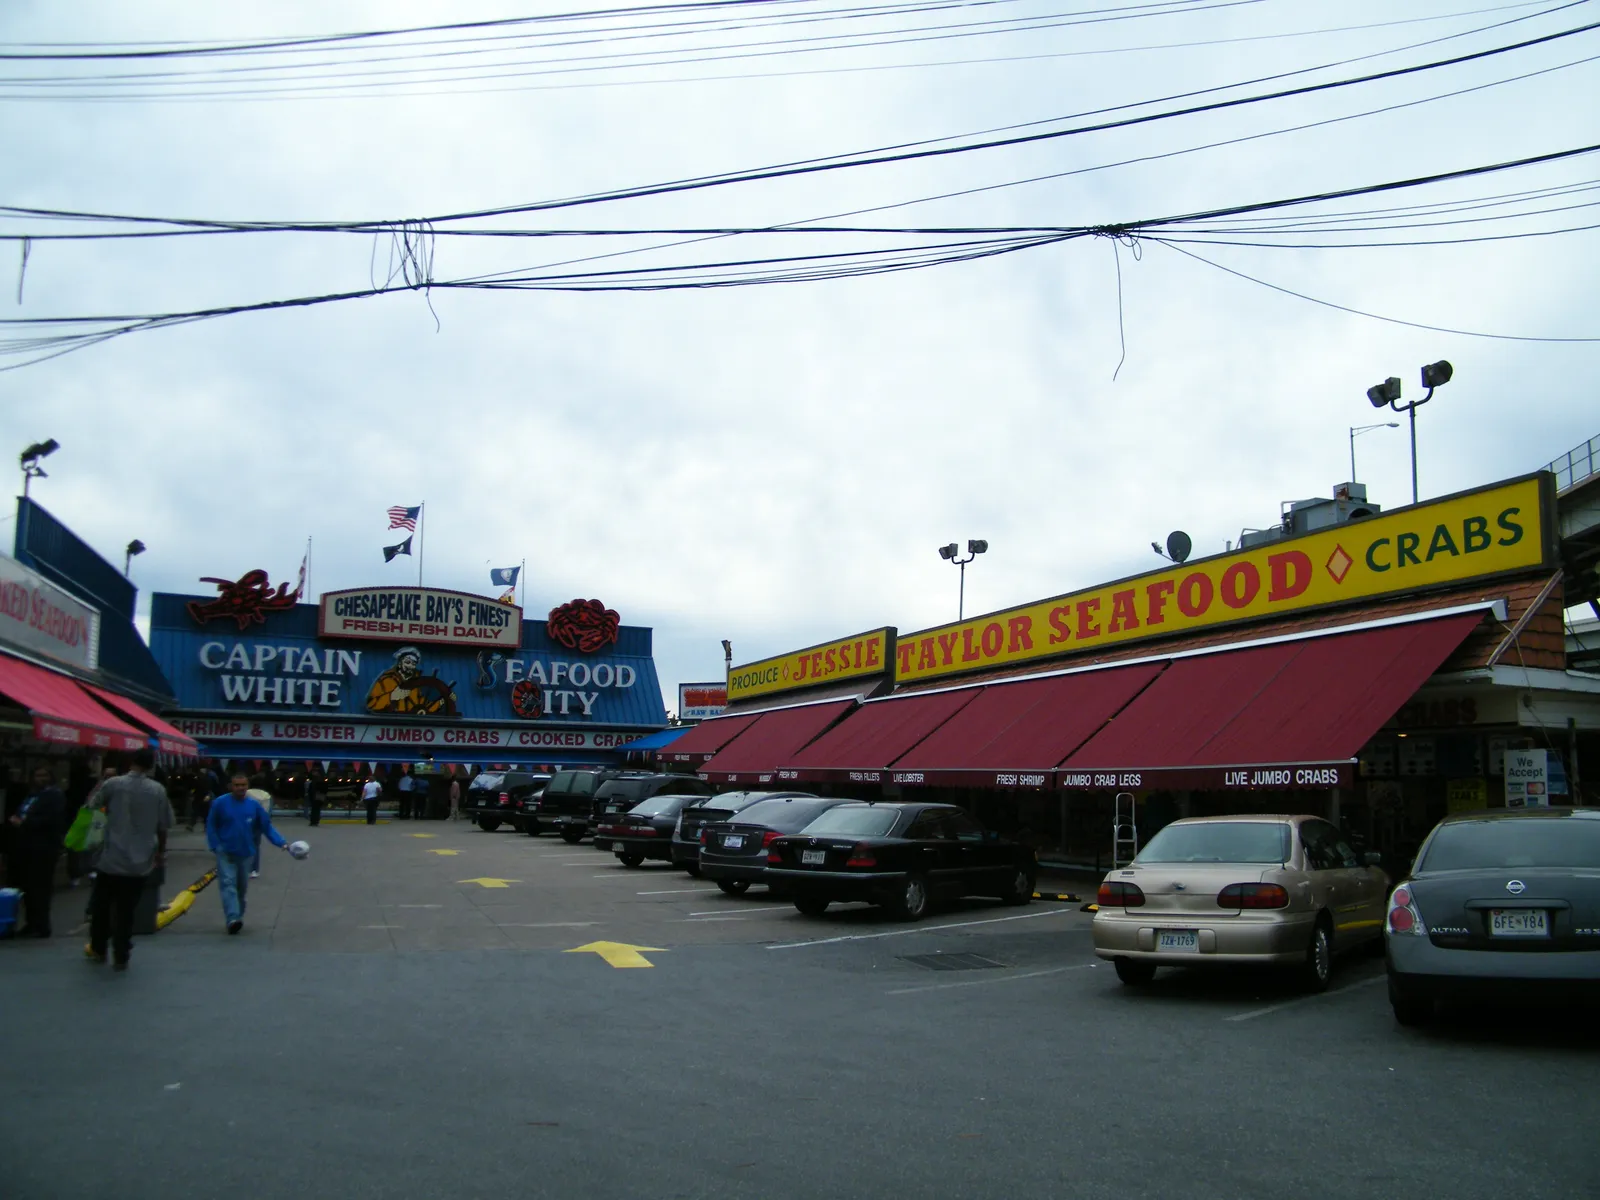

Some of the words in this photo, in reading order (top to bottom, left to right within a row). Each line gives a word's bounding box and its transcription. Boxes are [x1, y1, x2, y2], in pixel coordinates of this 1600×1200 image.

[1366, 507, 1524, 572] CRABS
[334, 594, 420, 621] CHESAPEAKE
[426, 595, 463, 624] BAY'S
[468, 601, 511, 627] FINEST
[897, 616, 1034, 674] TAYLOR
[1049, 550, 1313, 645] SEAFOOD
[342, 619, 403, 633] FRESH
[408, 624, 448, 636] FISH
[453, 627, 502, 639] DAILY
[200, 641, 362, 676] CAPTAIN
[731, 667, 779, 691] PRODUCE
[793, 637, 880, 681] JESSIE
[221, 674, 341, 706] WHITE
[251, 723, 263, 738] &
[274, 724, 355, 740] LOBSTER
[376, 728, 435, 743] JUMBO
[443, 729, 500, 744] CRABS
[519, 731, 585, 746] COOKED
[1516, 757, 1533, 767] We
[850, 772, 863, 781] FRESH
[864, 773, 880, 781] FILLETS
[893, 774, 903, 782] LIVE
[903, 774, 924, 783] LOBSTER
[996, 774, 1017, 785] FRESH
[1019, 774, 1045, 786] SHRIMP
[1064, 774, 1091, 786] JUMBO
[1094, 774, 1116, 786] CRAB
[1119, 774, 1141, 786] LEGS
[1225, 771, 1248, 785] LIVE
[1251, 770, 1291, 785] JUMBO
[1296, 769, 1338, 784] CRABS
[1508, 767, 1543, 778] Accept
